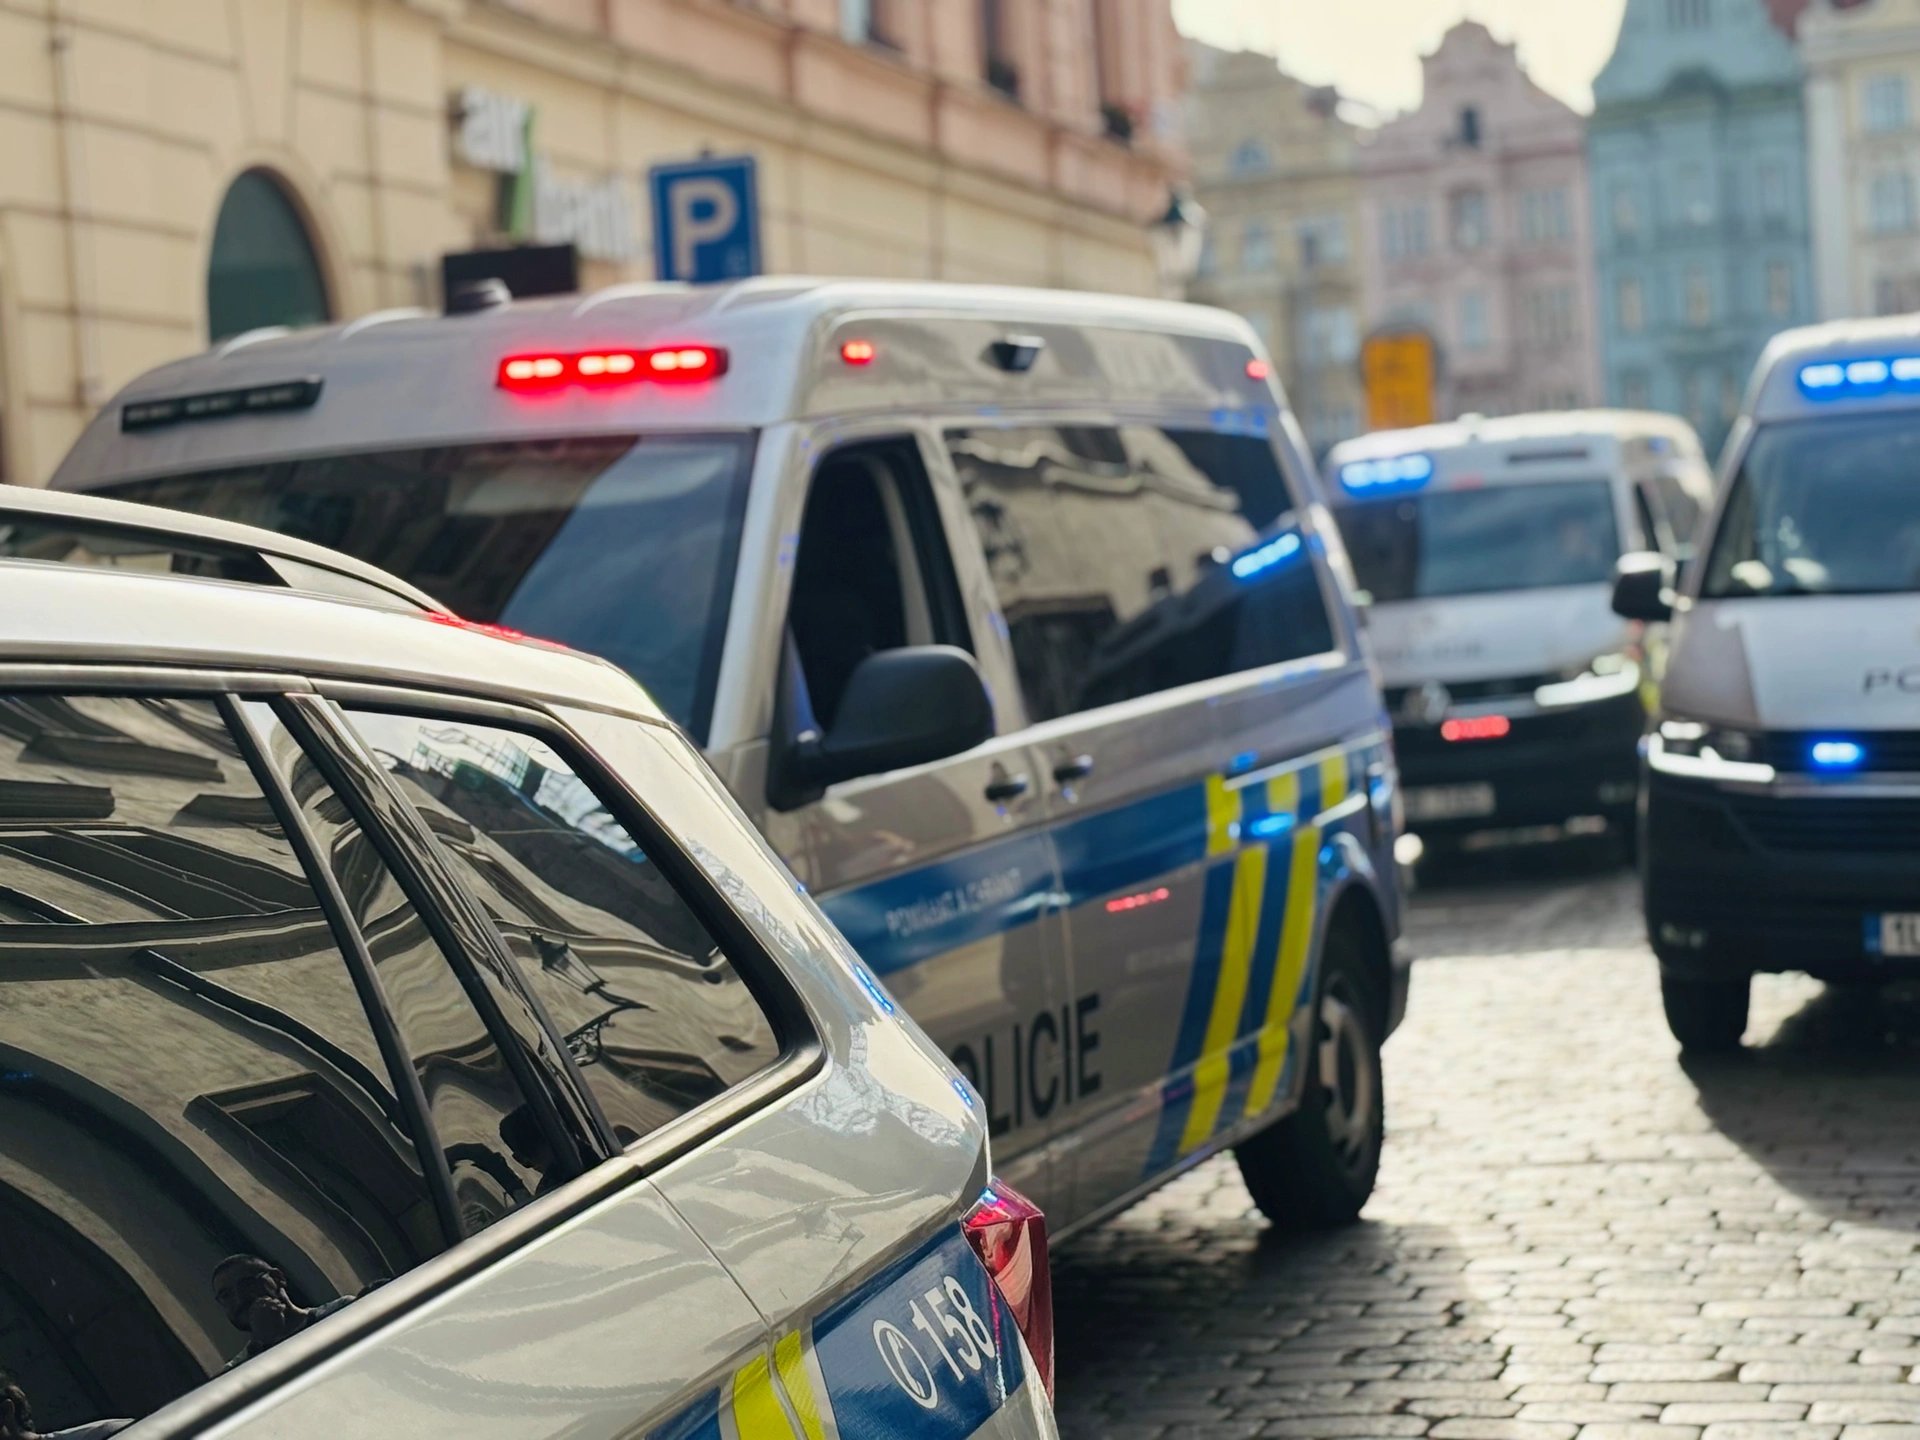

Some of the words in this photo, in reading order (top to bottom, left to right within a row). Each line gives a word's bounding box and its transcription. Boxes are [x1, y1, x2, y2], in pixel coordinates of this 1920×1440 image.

[666, 176, 739, 280] P
[950, 991, 1102, 1141] OLICIE
[909, 1275, 996, 1382] 158
